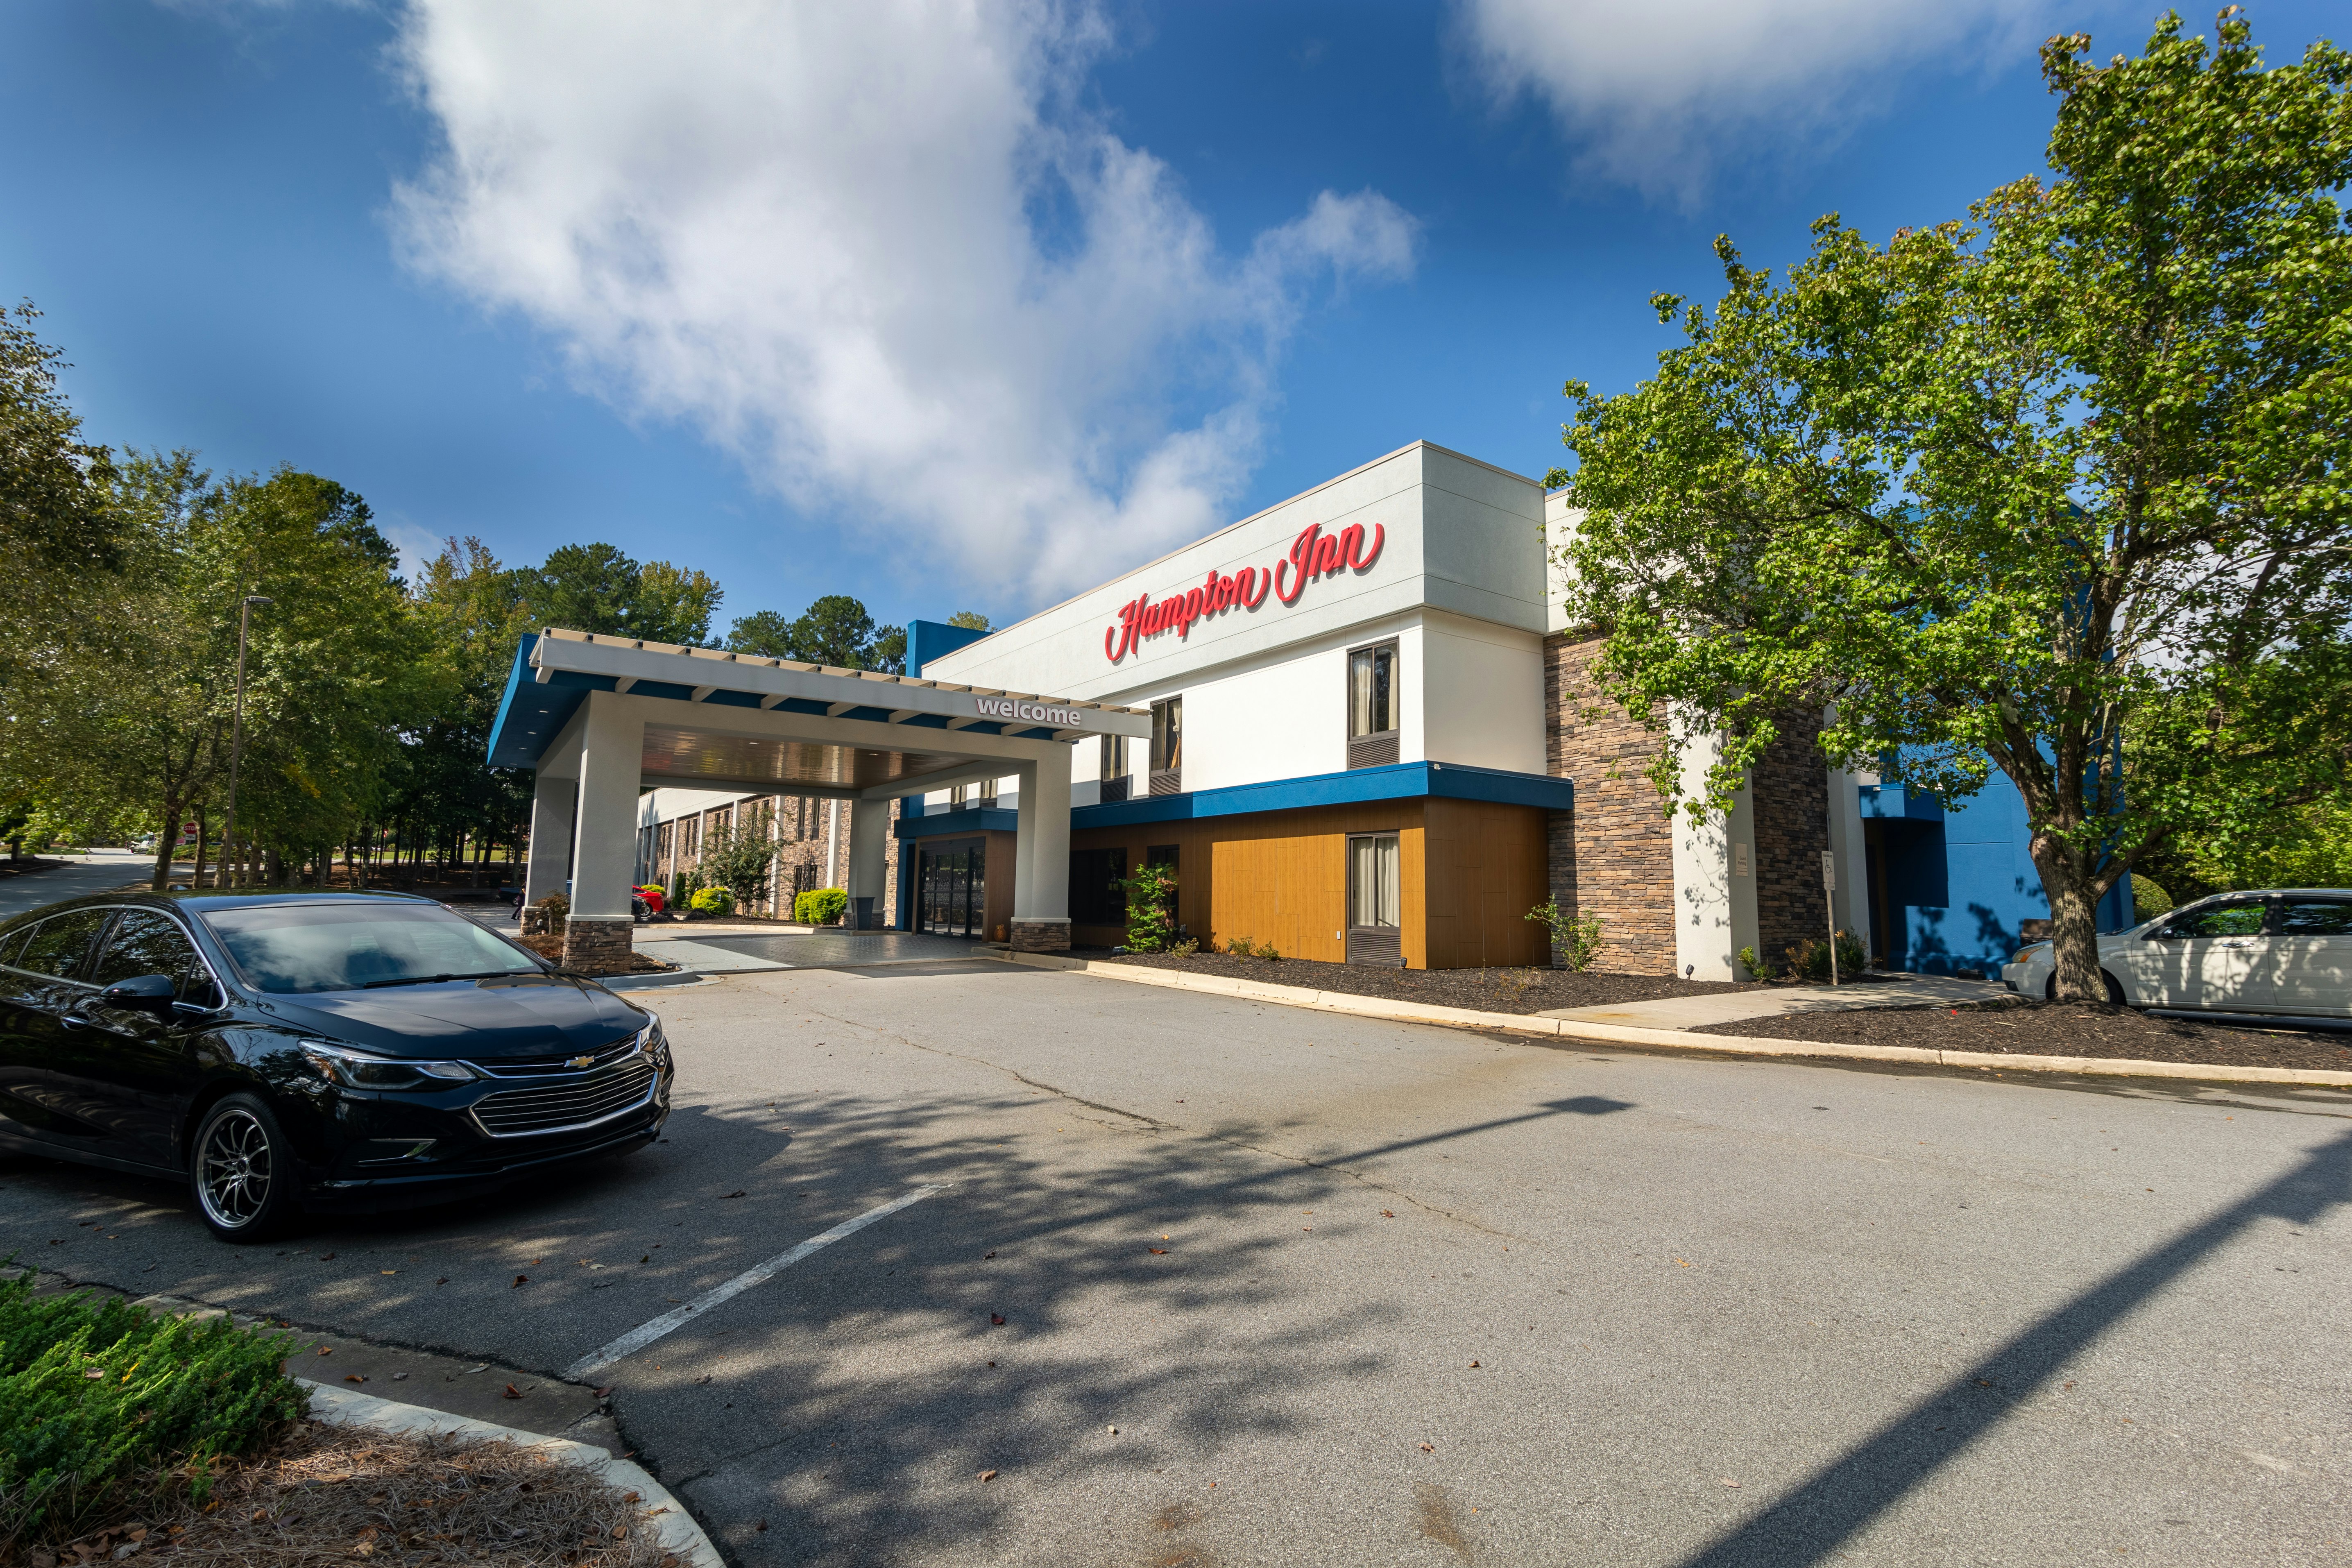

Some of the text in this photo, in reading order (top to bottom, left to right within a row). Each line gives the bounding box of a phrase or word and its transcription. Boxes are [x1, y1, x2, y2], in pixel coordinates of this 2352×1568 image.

[1105, 523, 1385, 661] Hampton Inn
[977, 698, 1081, 725] welcome
